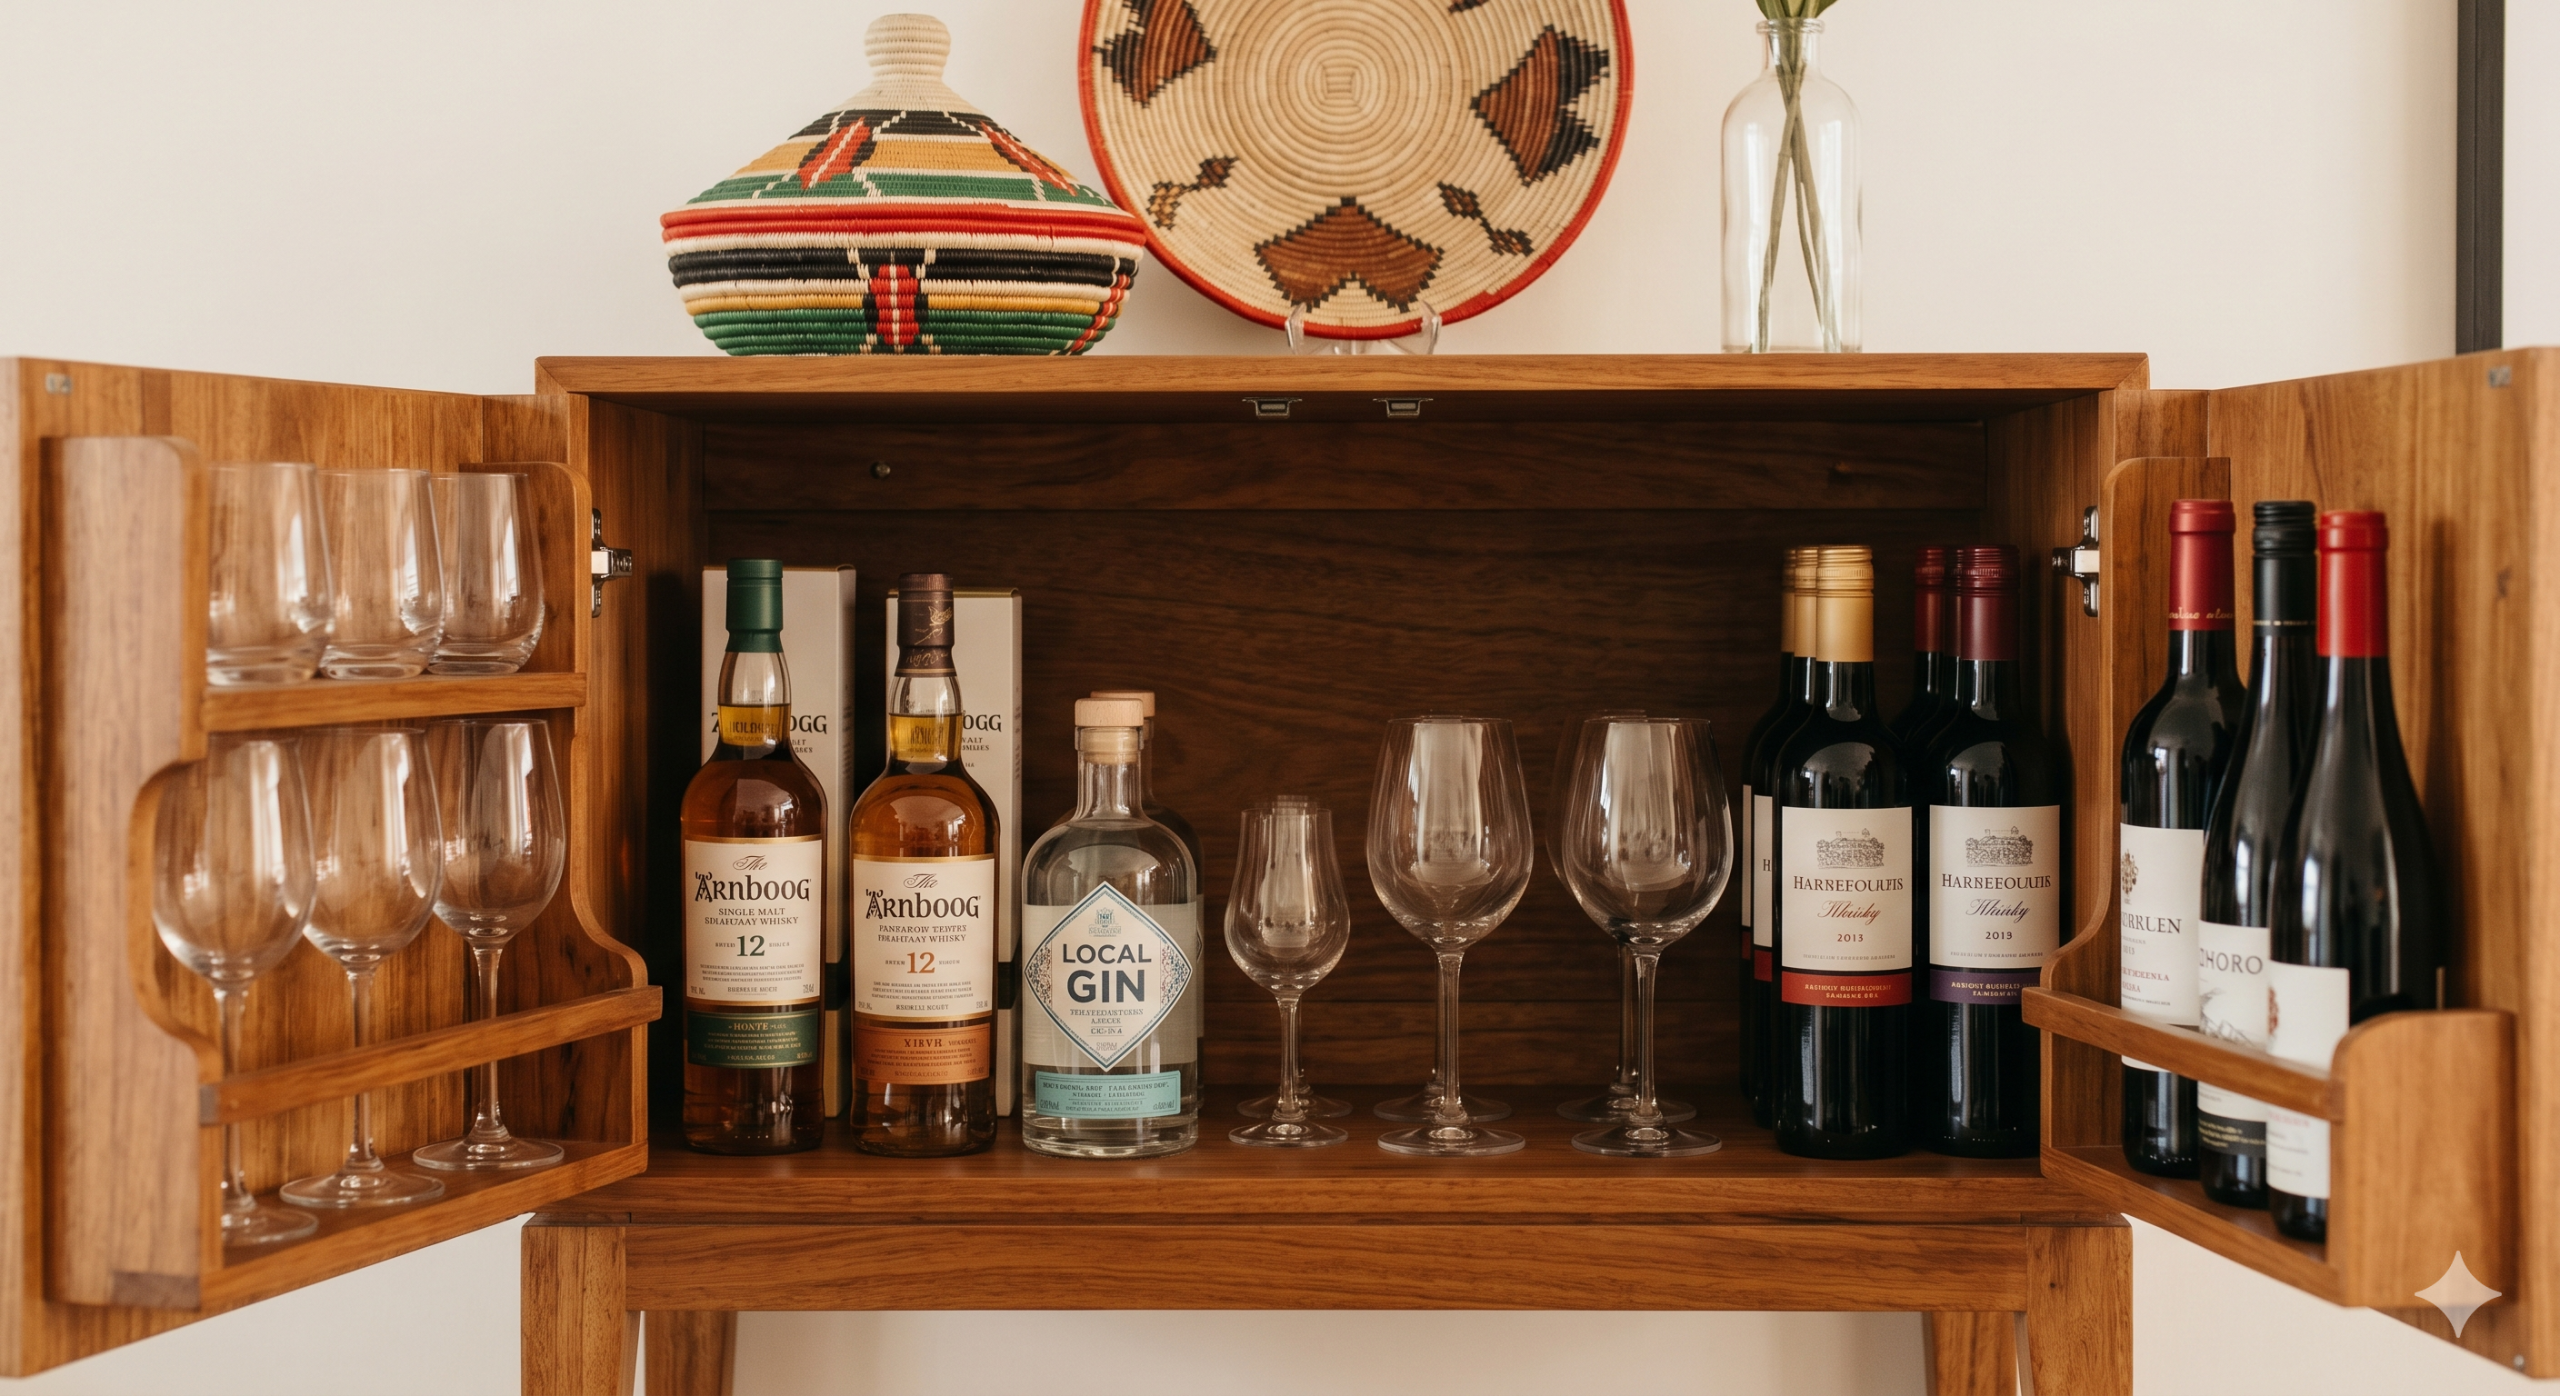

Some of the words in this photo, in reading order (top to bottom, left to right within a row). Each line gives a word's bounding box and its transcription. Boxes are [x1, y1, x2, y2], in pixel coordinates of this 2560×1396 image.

[732, 855, 768, 871] The
[903, 873, 939, 889] The
[718, 907, 755, 916] SINGLE
[757, 907, 786, 916] MALT
[760, 916, 799, 926] WHISKY
[736, 934, 766, 957] 12
[928, 933, 967, 943] WHISKY
[1837, 934, 1864, 943] 2013
[1062, 943, 1152, 964] LOCAL
[906, 951, 936, 974] 12
[1066, 969, 1145, 1004] GIN
